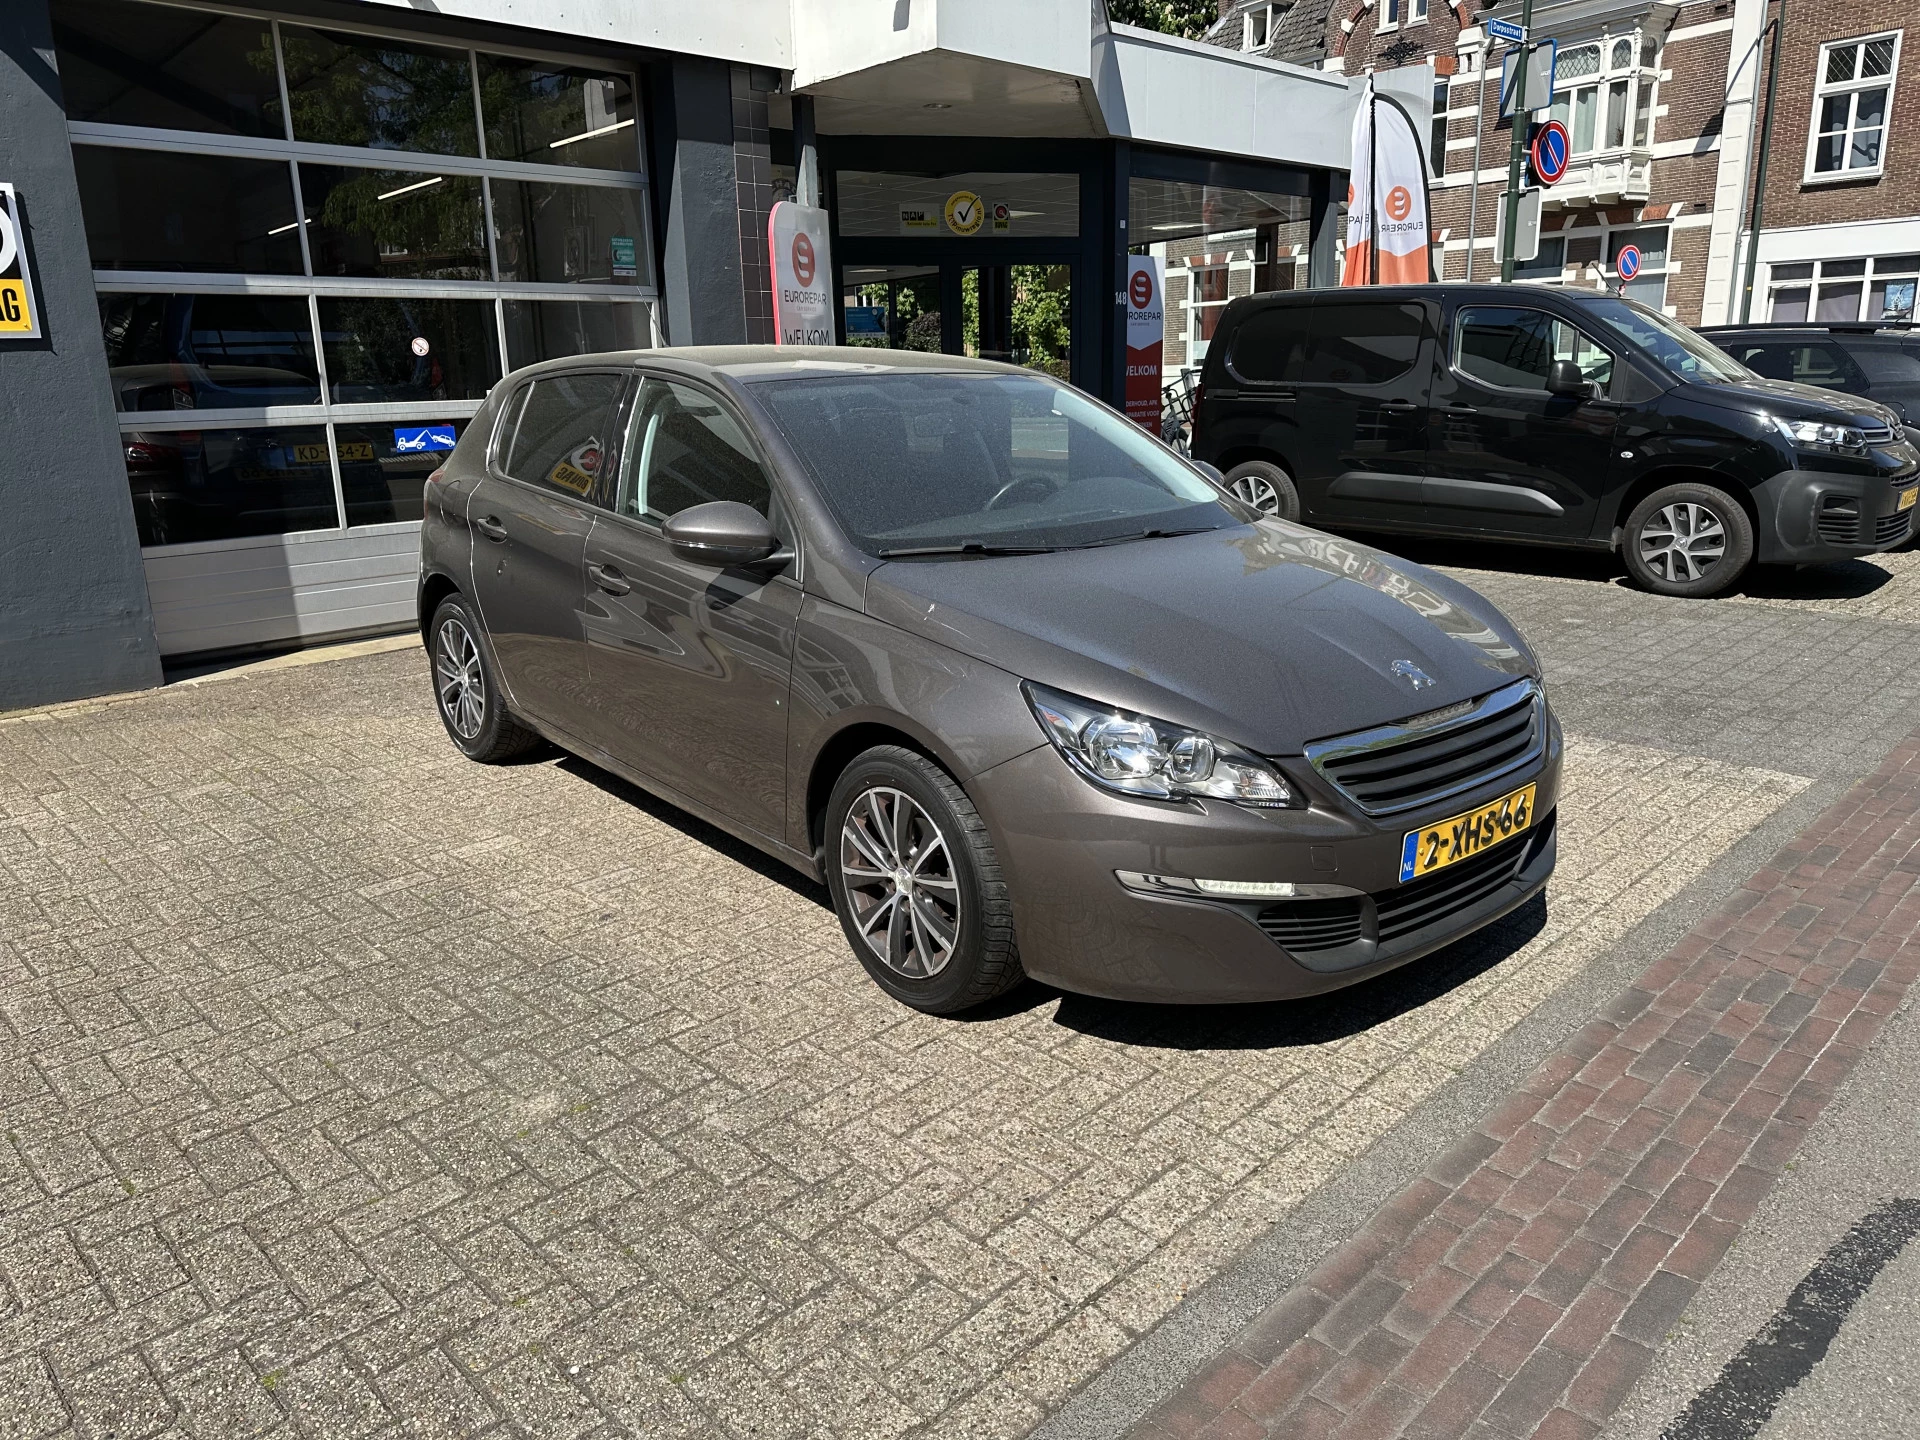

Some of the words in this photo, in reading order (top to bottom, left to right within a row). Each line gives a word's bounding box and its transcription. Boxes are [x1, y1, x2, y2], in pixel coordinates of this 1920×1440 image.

[1493, 21, 1521, 37] Dorpsstraat
[784, 290, 827, 305] EUROREPAR
[1115, 291, 1127, 305] 148
[1127, 311, 1162, 321] ROREPAR
[1424, 794, 1527, 871] 2-XHS-66
[1403, 861, 1413, 873] NL
